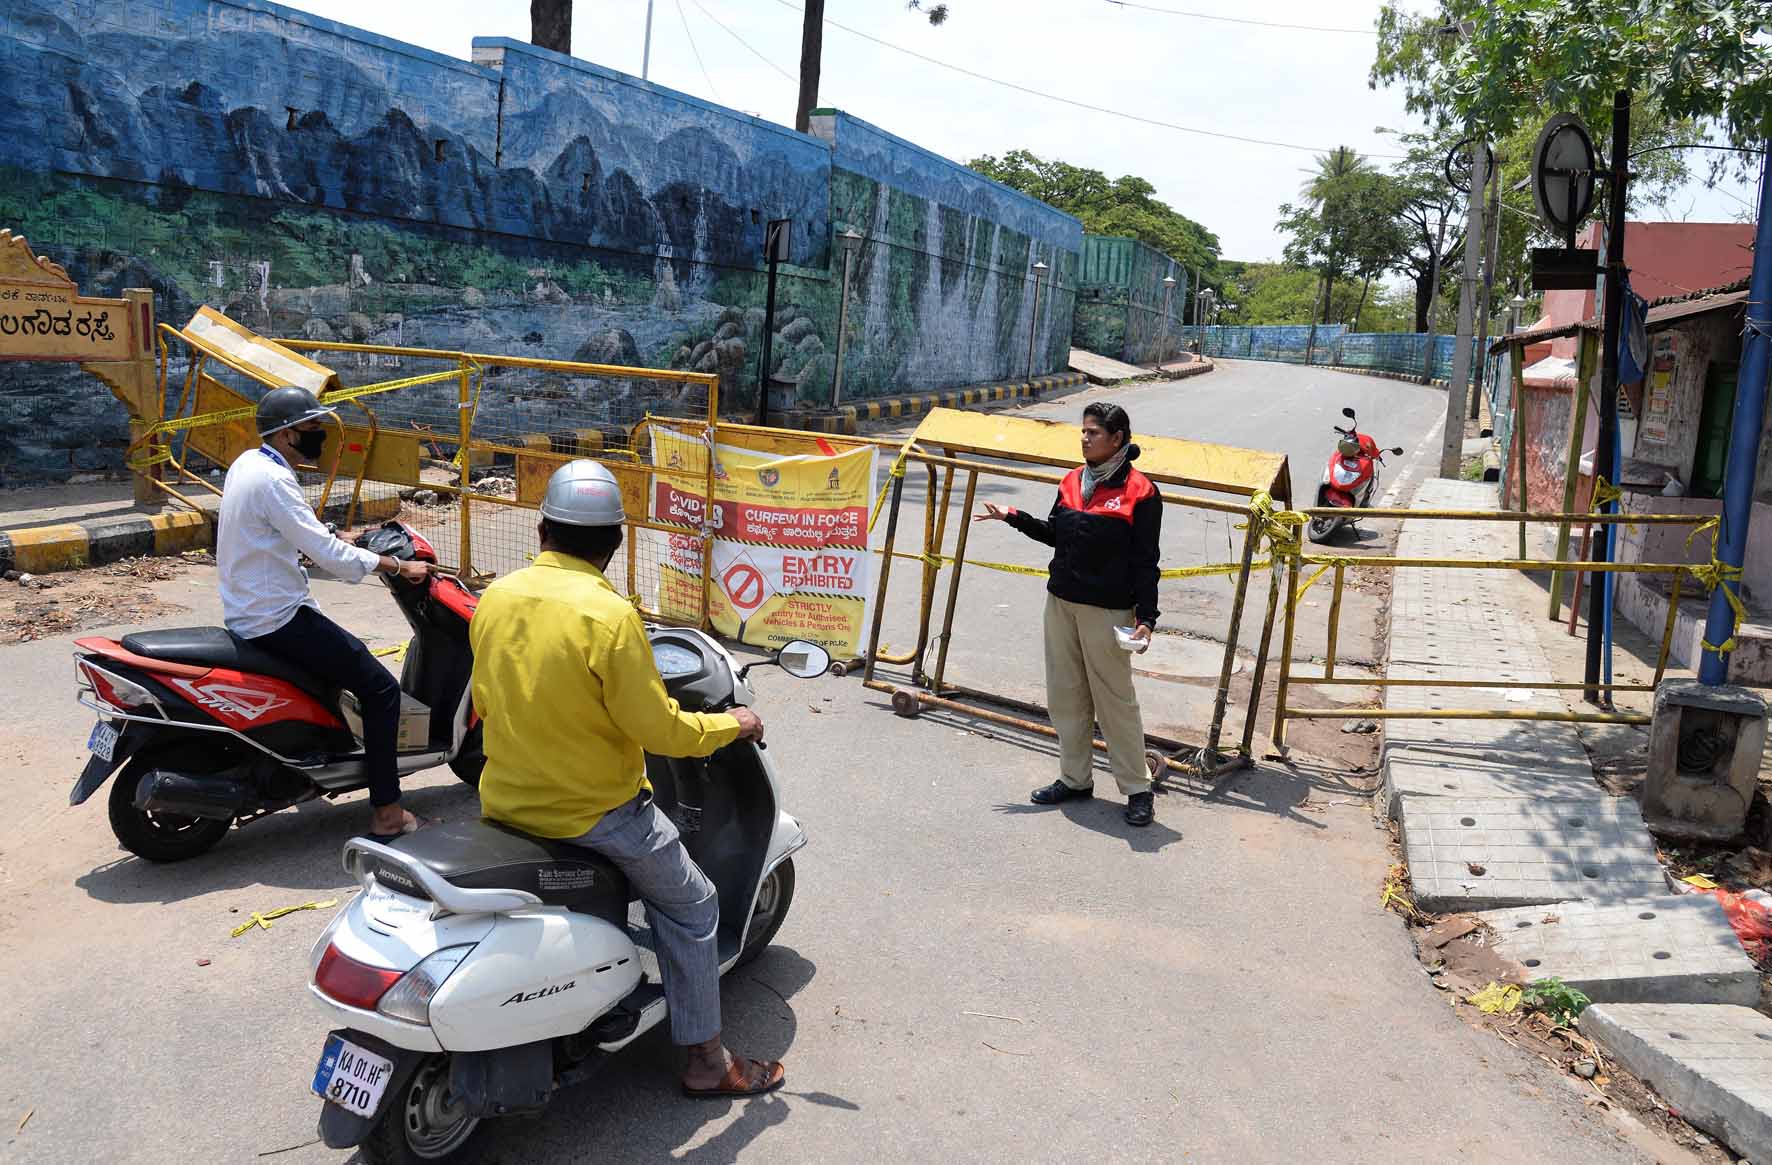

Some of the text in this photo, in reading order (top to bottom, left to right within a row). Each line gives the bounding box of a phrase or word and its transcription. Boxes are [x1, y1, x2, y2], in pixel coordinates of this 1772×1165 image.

[0, 308, 73, 336] ಲಗೌಡ
[744, 509, 799, 525] CURFEW
[802, 512, 815, 526] IN
[782, 555, 855, 575] ENTRY
[787, 599, 833, 613] STRICTLY
[378, 868, 414, 888] HONDA
[499, 980, 576, 1007] Activa
[338, 1050, 354, 1073] KA
[332, 1077, 371, 1110] 8710
